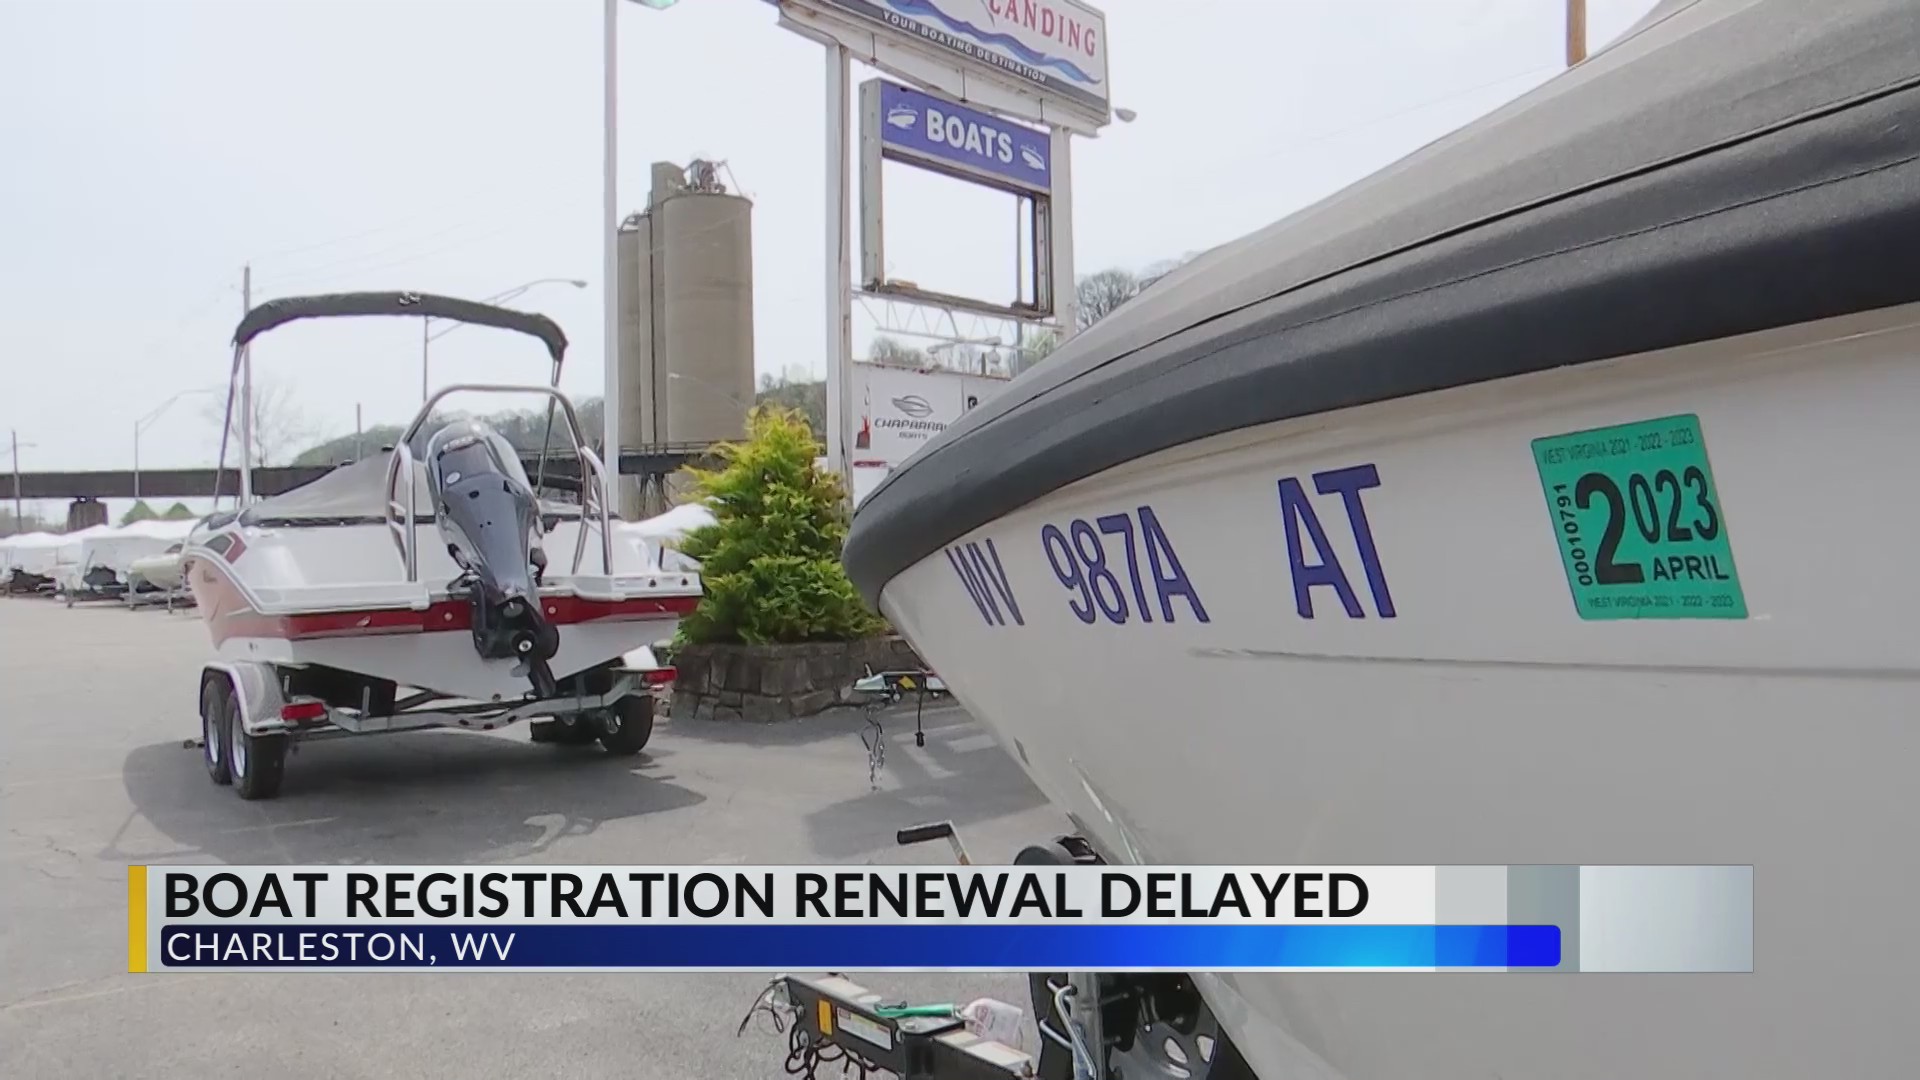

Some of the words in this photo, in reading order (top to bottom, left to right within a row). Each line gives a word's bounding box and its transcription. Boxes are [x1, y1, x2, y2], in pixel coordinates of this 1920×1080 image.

[883, 10, 917, 32] YOUR
[921, 26, 973, 54] BOATING
[977, 48, 1047, 83] DESTINATION
[926, 108, 1013, 164] BOATS
[944, 538, 1025, 626] WV
[1041, 506, 1210, 625] 987A
[1277, 463, 1397, 620] AT
[1553, 483, 1593, 586] 00010791
[1575, 466, 1719, 586] 2023
[1653, 555, 1730, 581] APRIL
